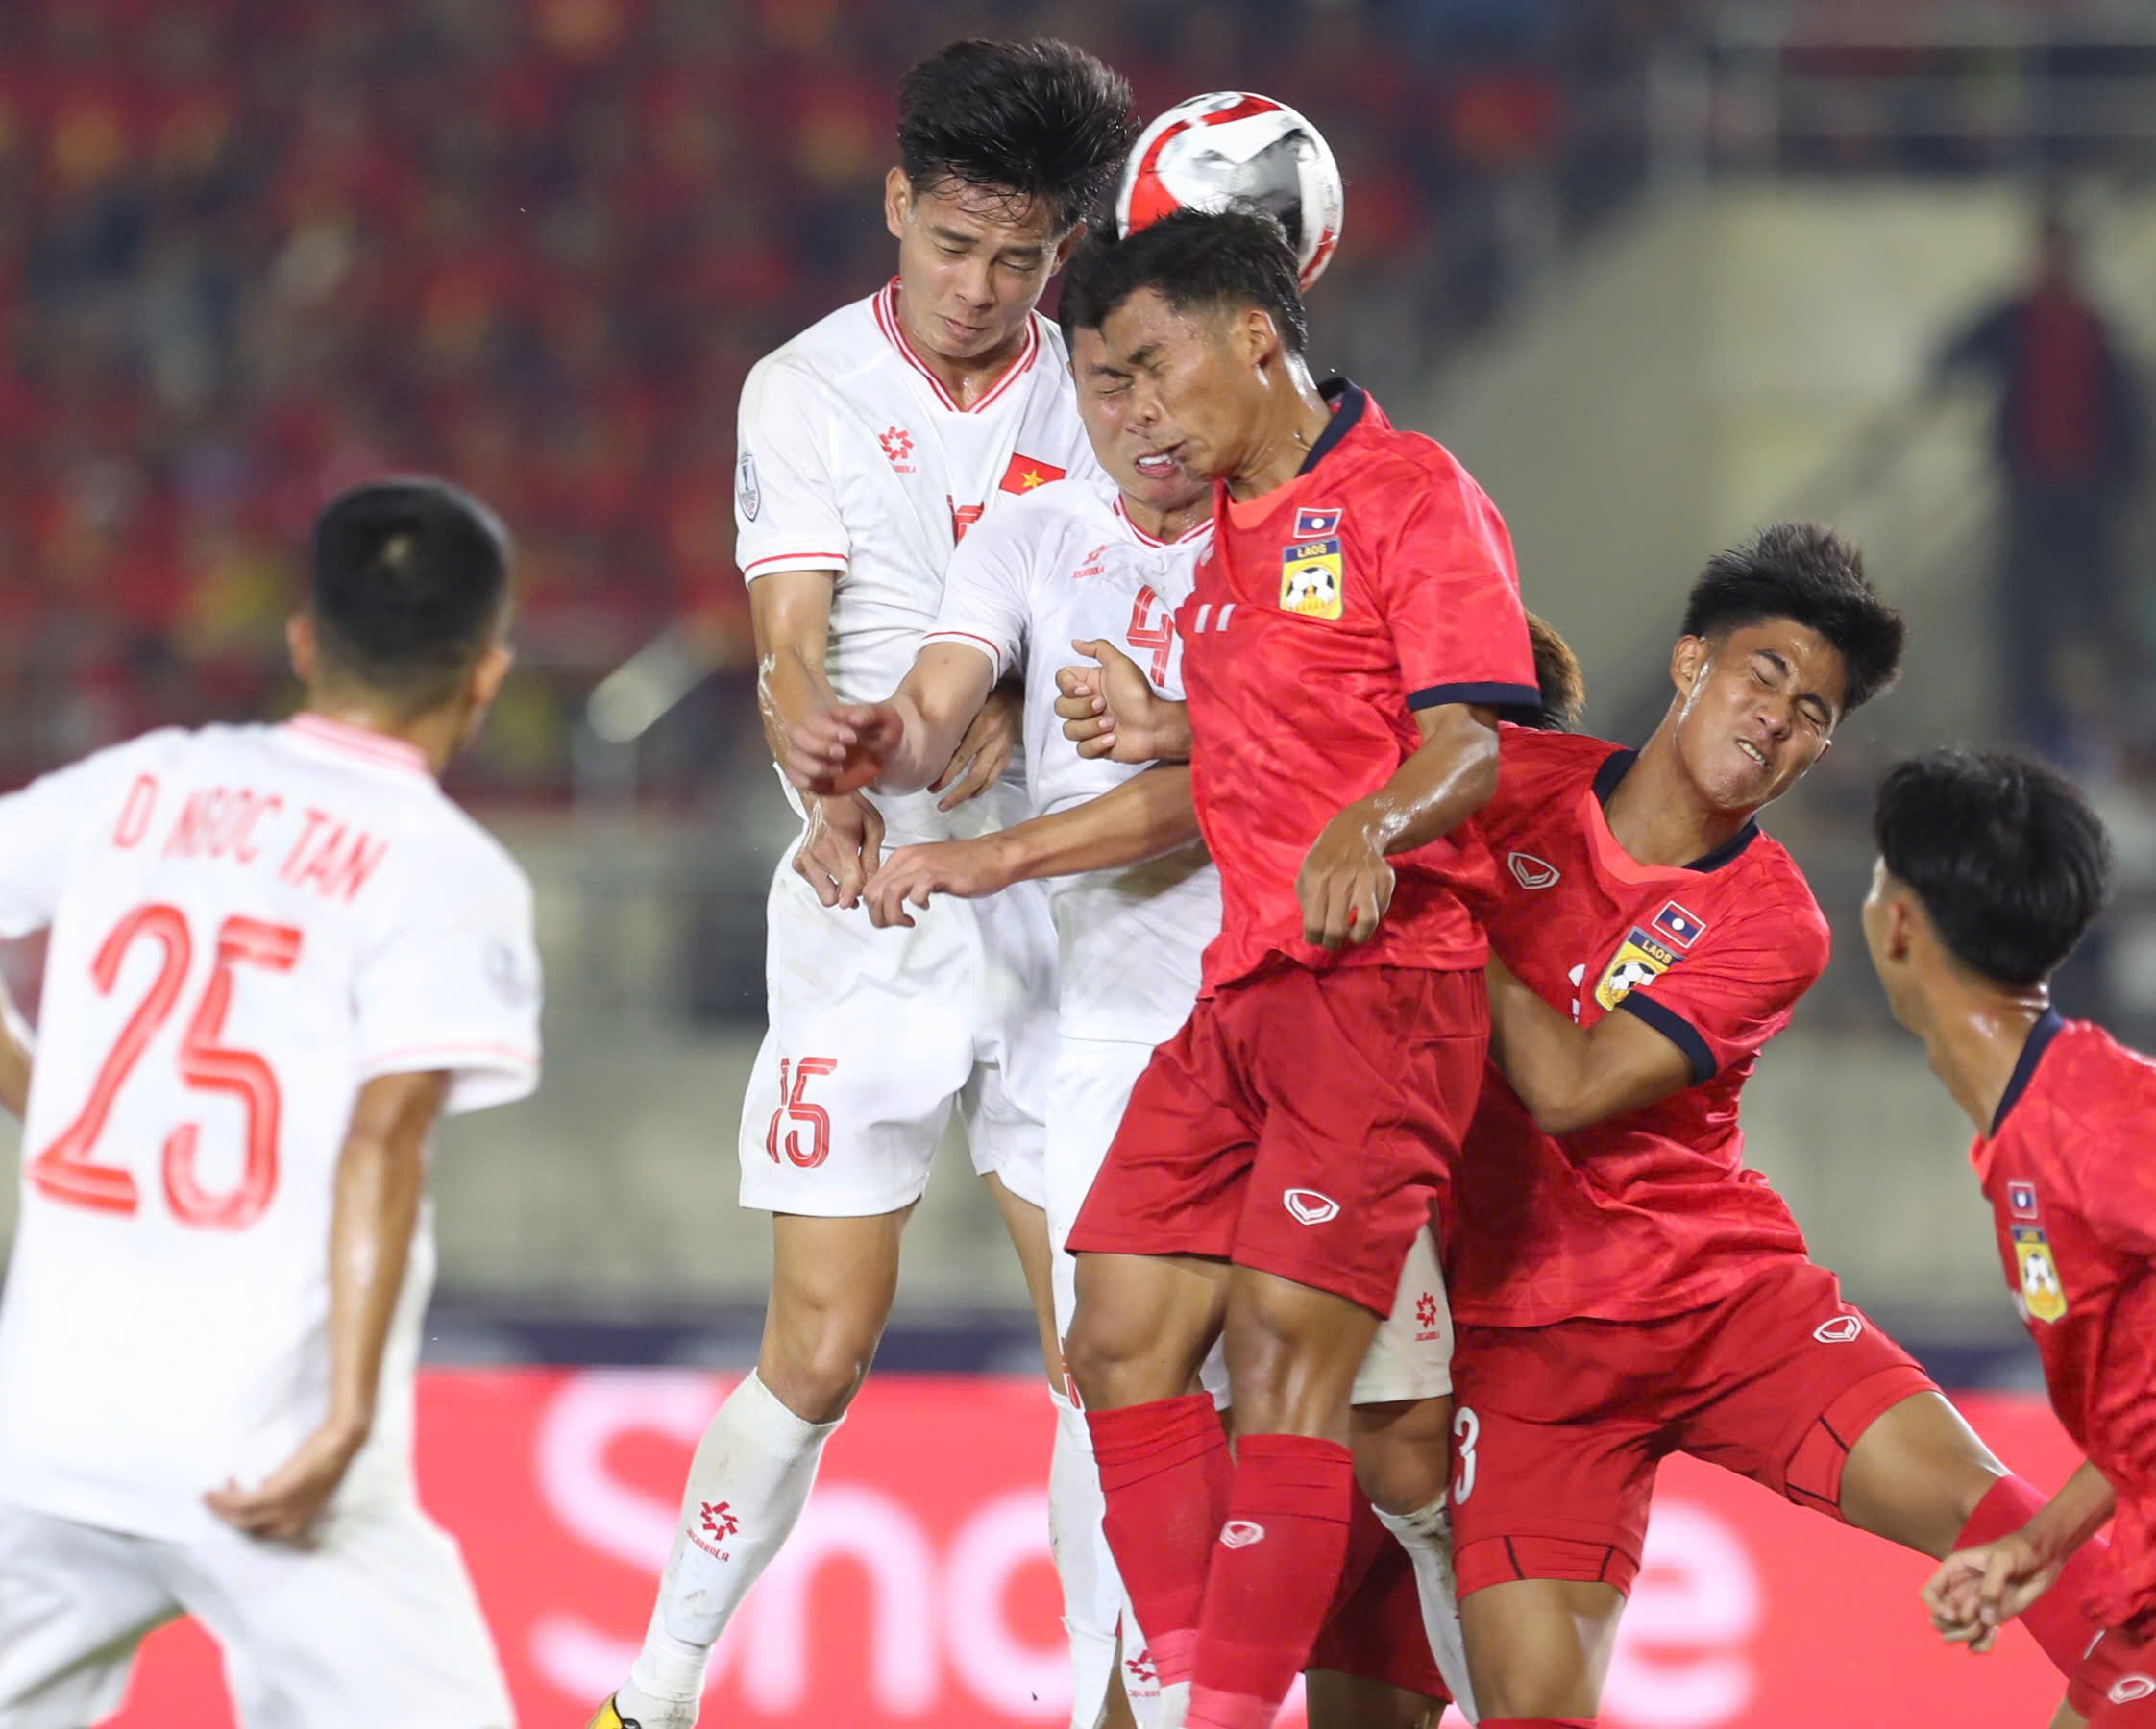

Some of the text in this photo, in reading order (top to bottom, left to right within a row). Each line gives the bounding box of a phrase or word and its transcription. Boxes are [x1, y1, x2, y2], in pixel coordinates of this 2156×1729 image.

[1295, 543, 1328, 559] LAOS
[1125, 583, 1176, 689] 4
[278, 806, 390, 906] TAN
[1641, 939, 1674, 965] LAOS
[24, 900, 306, 1233] 25
[766, 1056, 838, 1169] 15
[1453, 1406, 1480, 1506] 3
